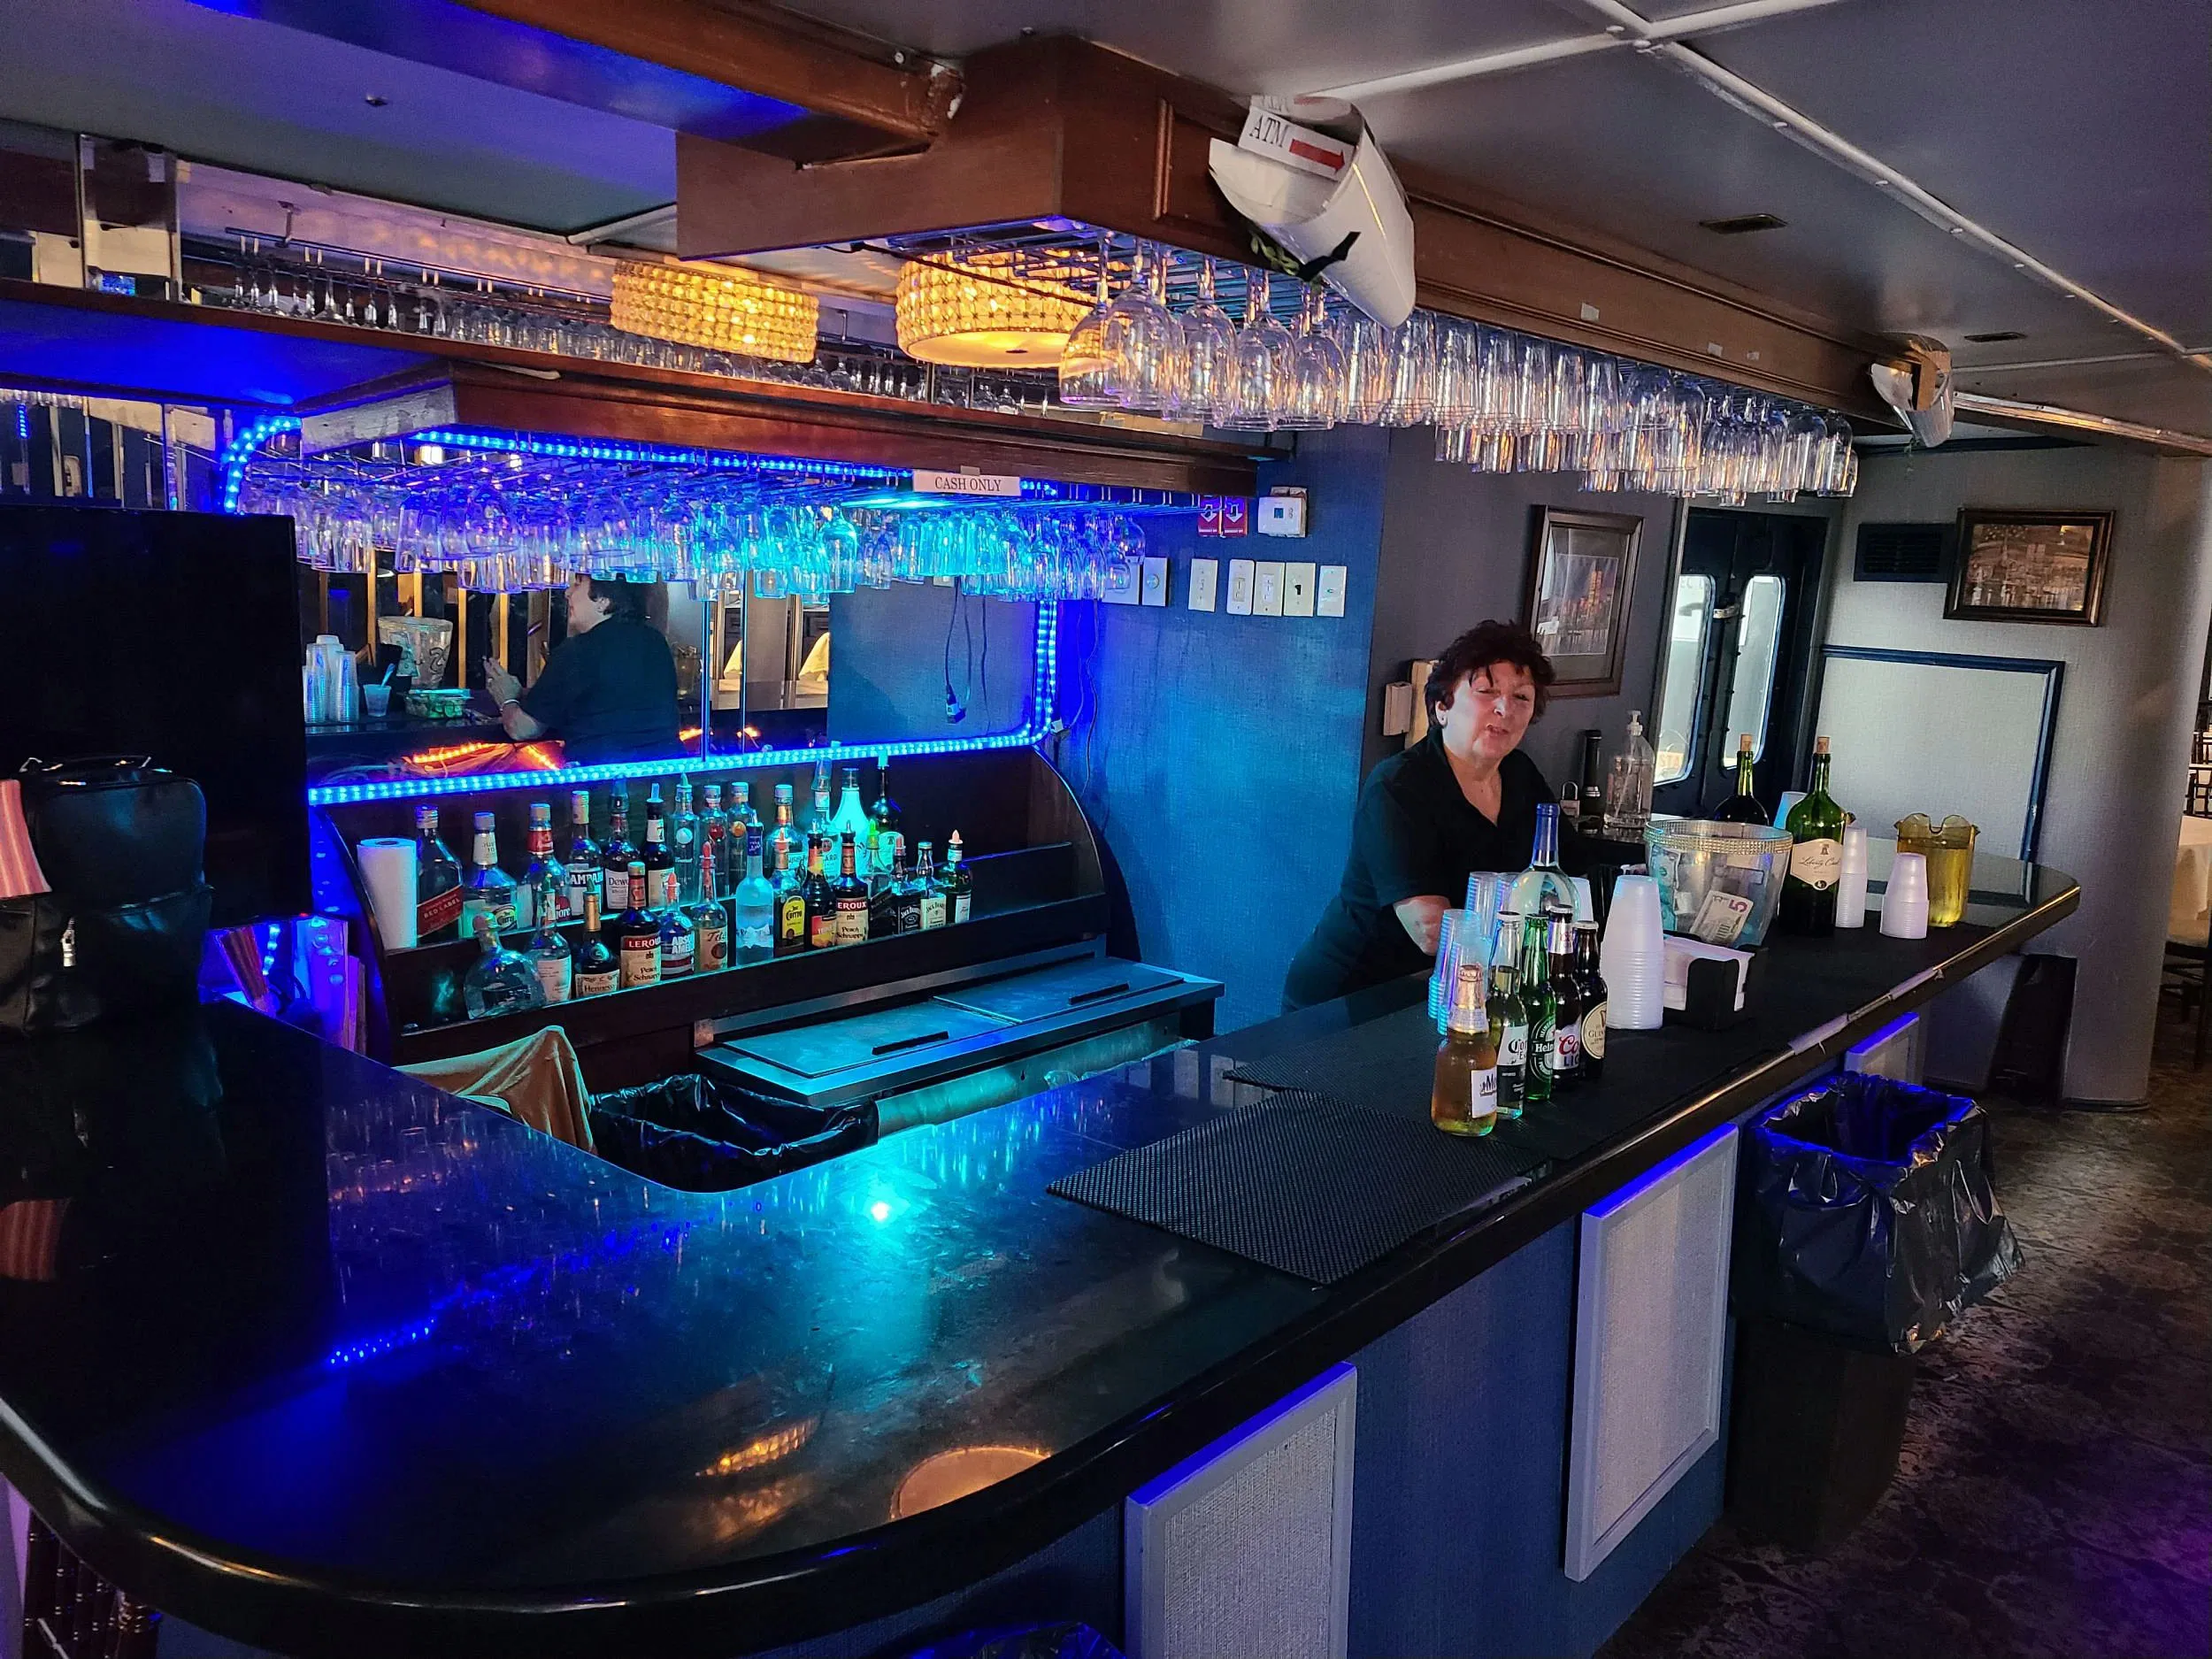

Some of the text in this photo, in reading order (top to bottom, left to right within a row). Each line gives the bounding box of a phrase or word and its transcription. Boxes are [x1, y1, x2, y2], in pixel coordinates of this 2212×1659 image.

[1248, 114, 1289, 148] ATM
[934, 476, 1001, 492] CASH ONLY
[424, 909, 439, 918] RED
[439, 897, 460, 911] LABEL
[1728, 899, 1748, 913] 5
